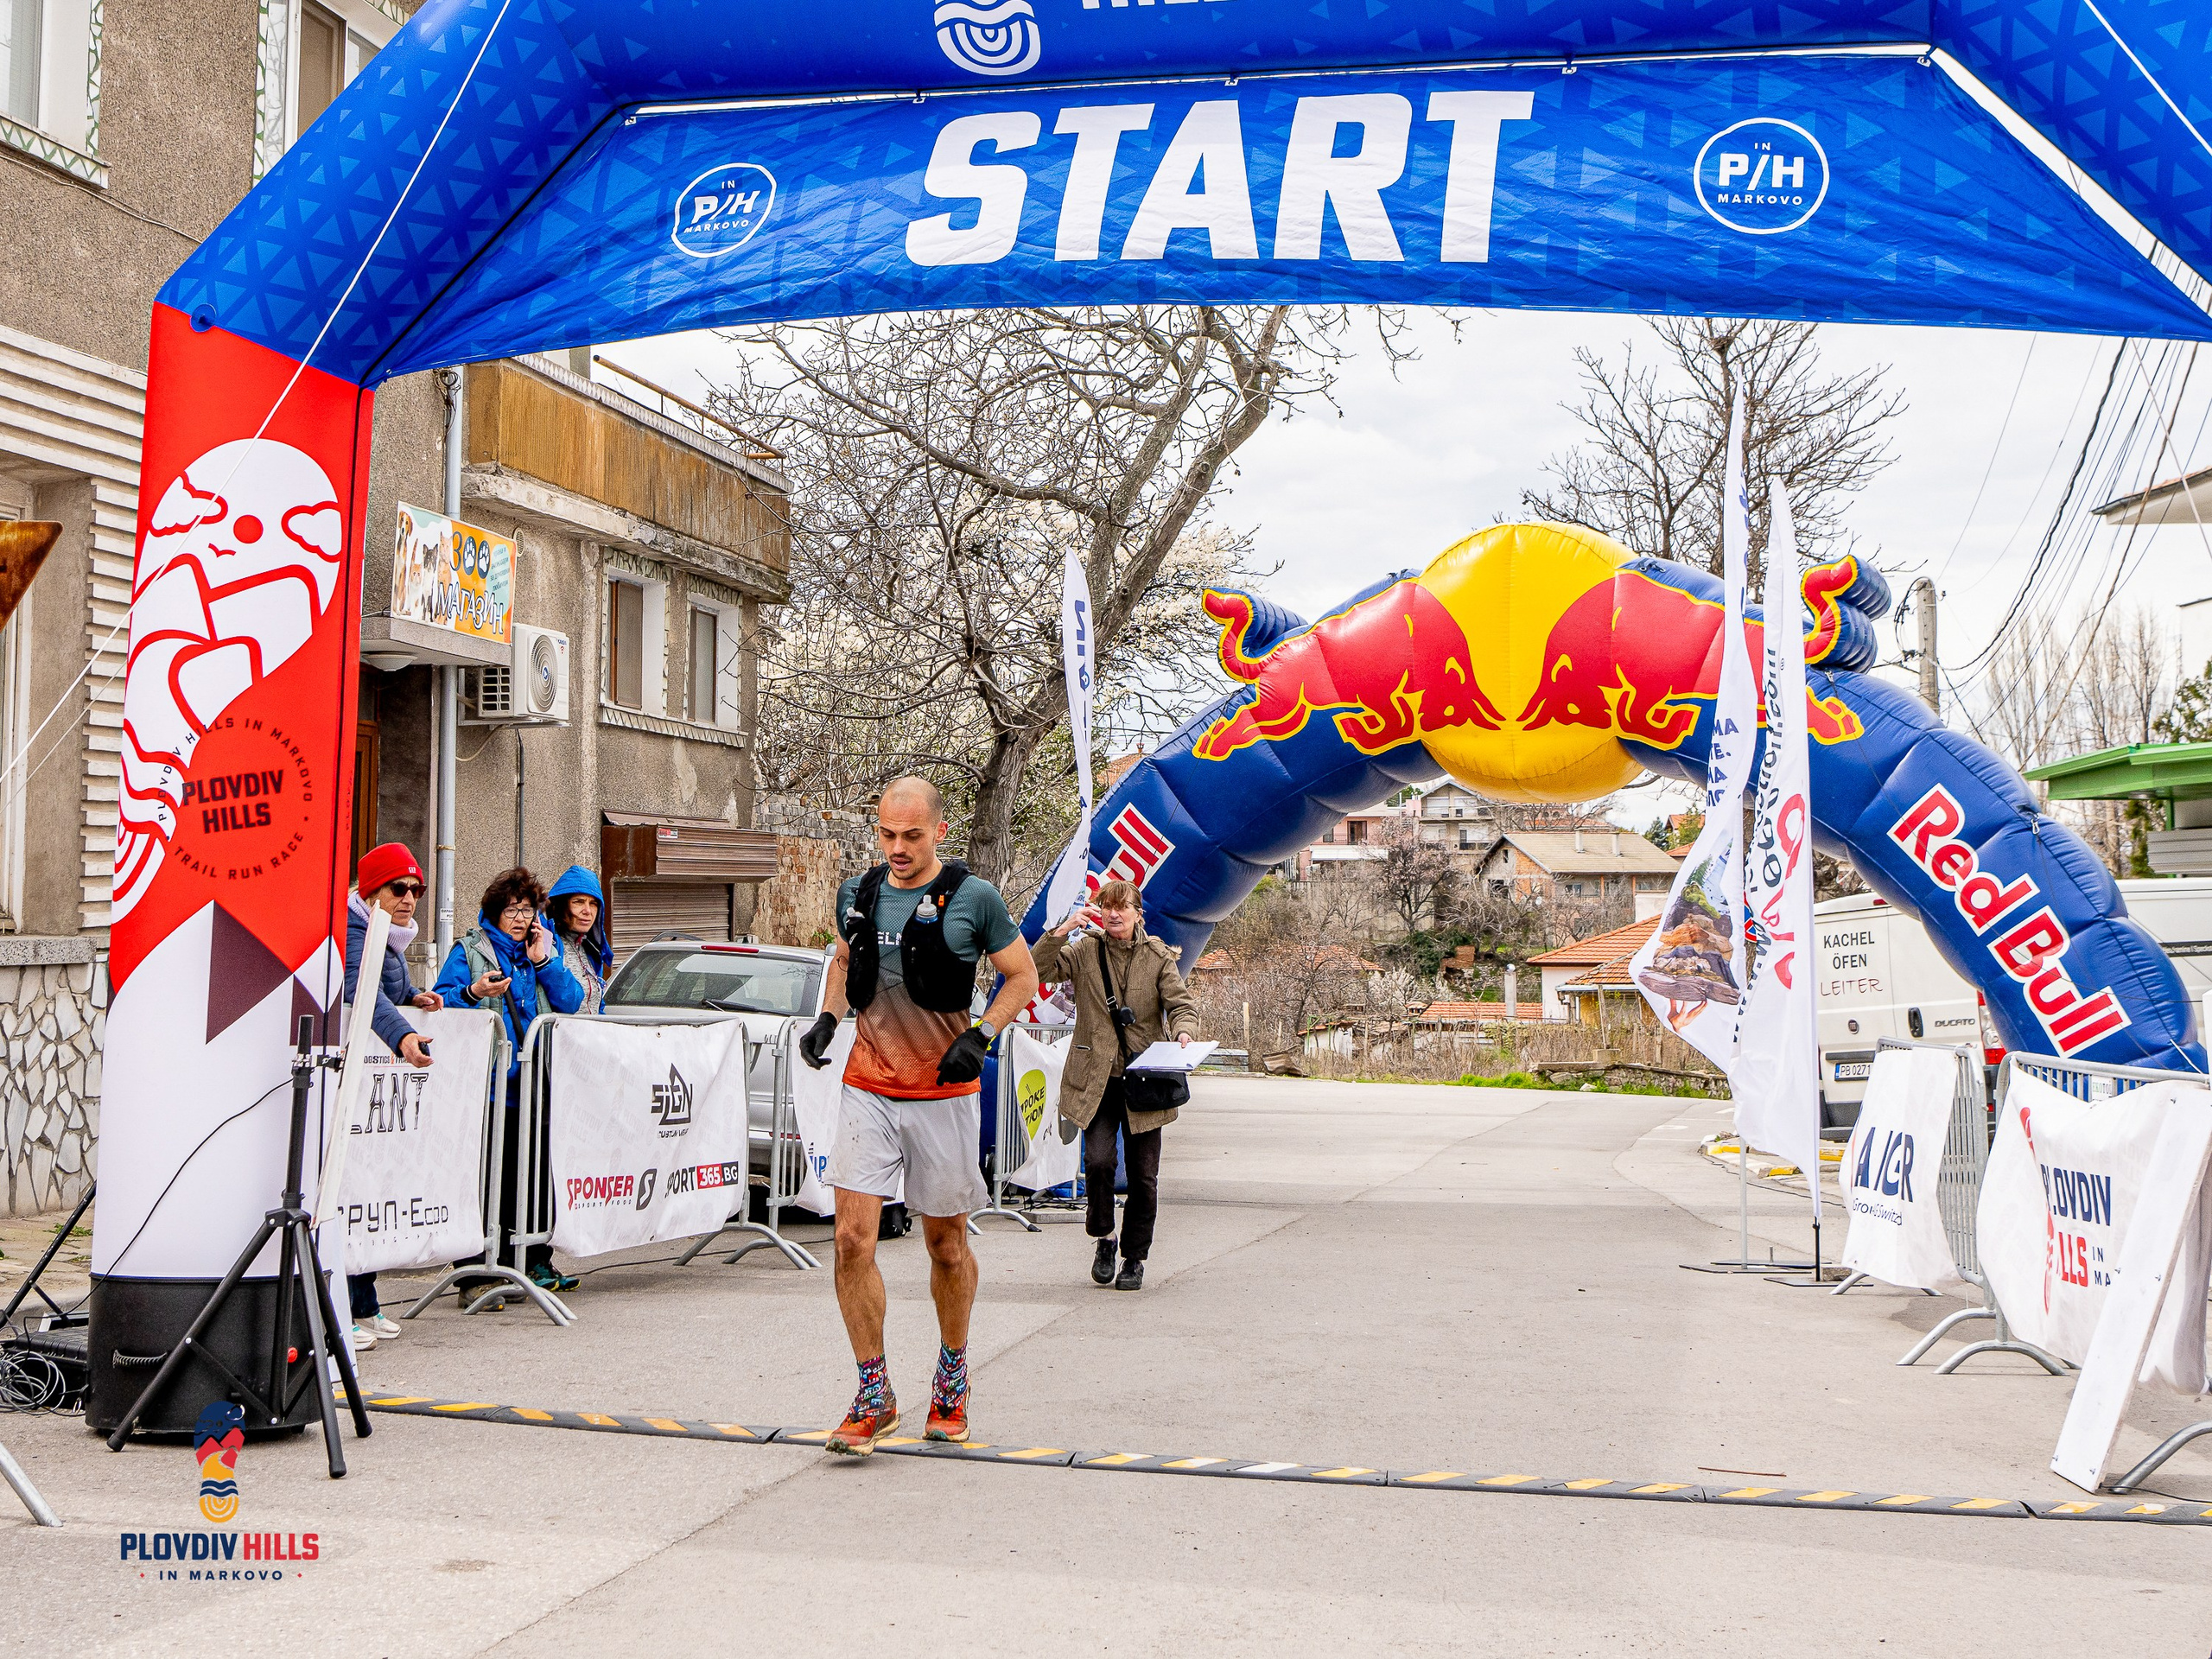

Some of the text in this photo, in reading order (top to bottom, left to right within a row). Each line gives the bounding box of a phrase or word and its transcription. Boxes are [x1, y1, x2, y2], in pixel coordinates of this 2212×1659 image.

[1754, 142, 1771, 151] IN
[721, 180, 735, 189] IN
[904, 91, 1535, 267] START
[1718, 153, 1804, 191] P/H
[690, 190, 761, 225] P/H
[1717, 193, 1803, 207] MARKOVO
[683, 219, 759, 234] MARKOVO
[437, 581, 505, 635] МАГАЗИН
[157, 716, 314, 822] PLOVDIV HILLS IN MARKOVO
[181, 768, 285, 807] PLOVDIV
[201, 802, 272, 835] HILLS
[173, 831, 304, 880] TRAIL RUN RACE
[1891, 786, 2127, 1055] Red Bull
[1823, 931, 1875, 949] KACHEL
[1833, 953, 1868, 969] ÖFEN
[1820, 978, 1884, 996] LEITER
[1935, 1018, 1976, 1027] DUCATO
[1840, 1065, 1871, 1076] PB 0271
[567, 1175, 634, 1211] SPONSER
[2056, 1231, 2088, 1287] LLS
[2092, 1246, 2104, 1262] IN
